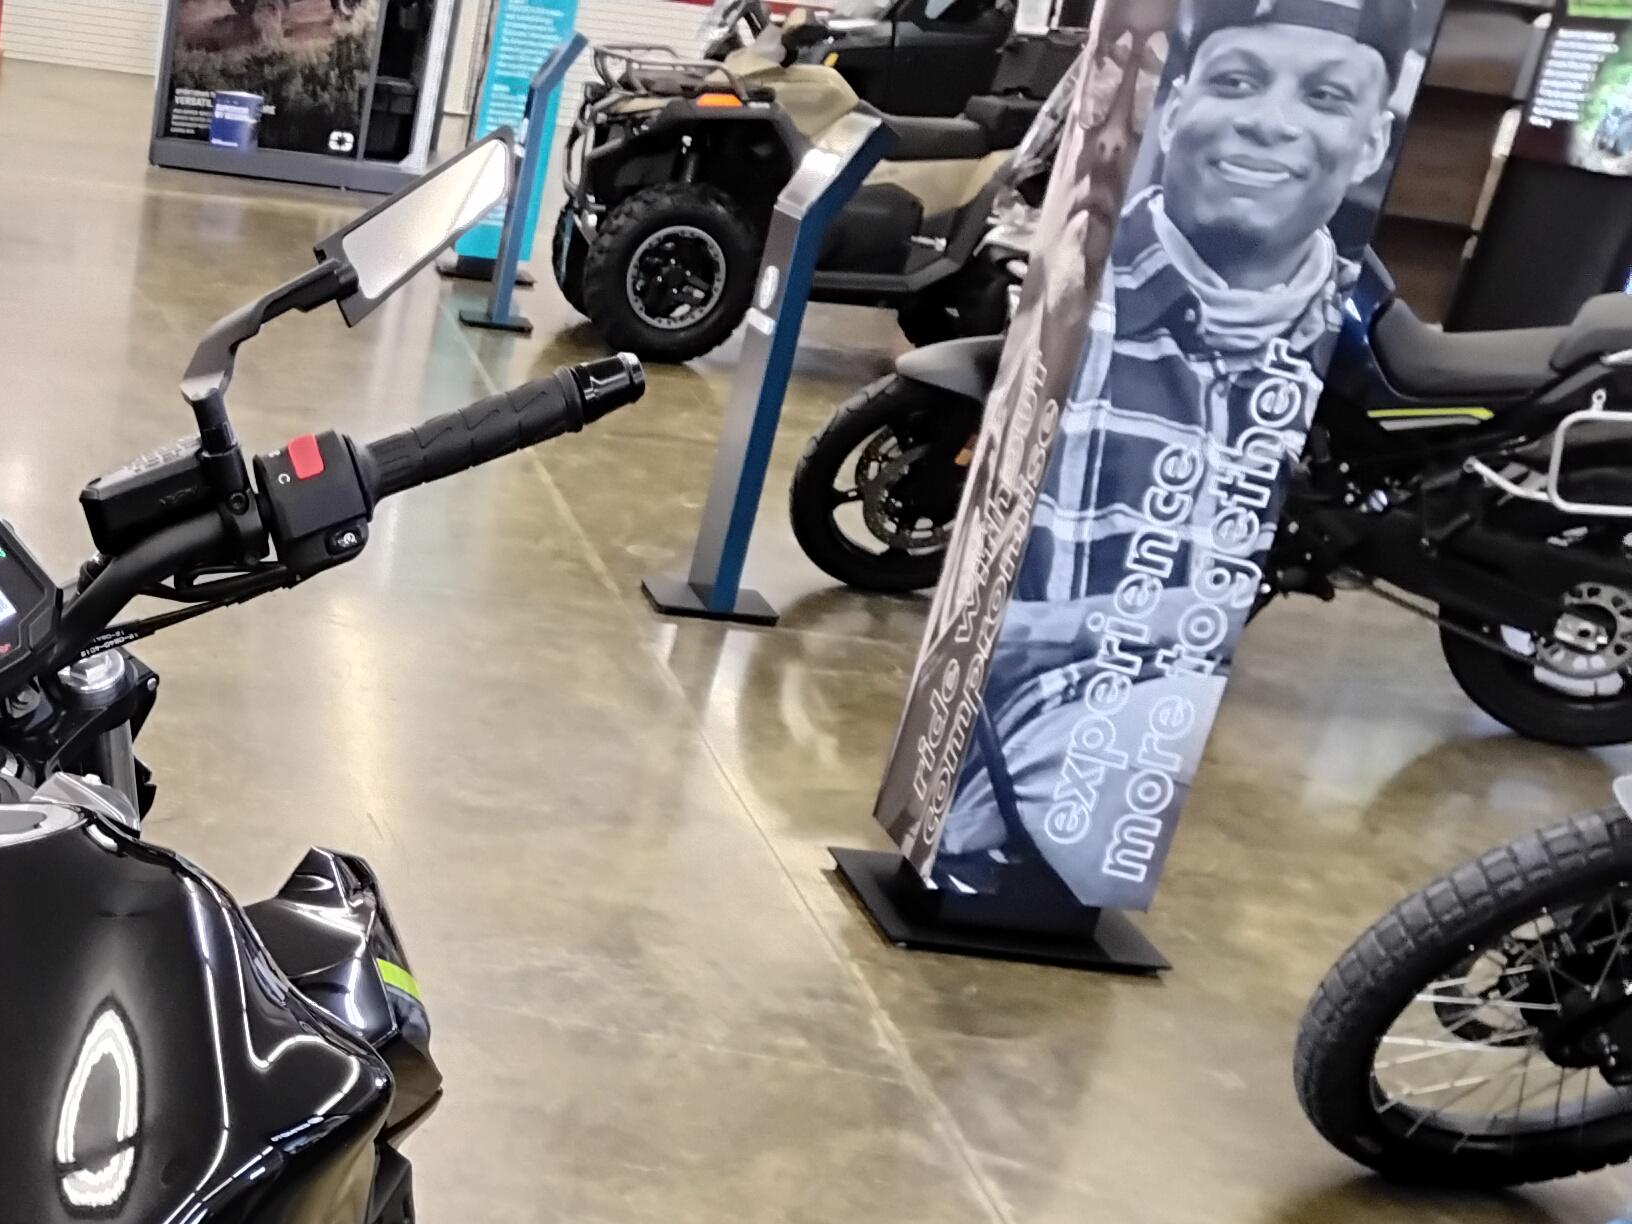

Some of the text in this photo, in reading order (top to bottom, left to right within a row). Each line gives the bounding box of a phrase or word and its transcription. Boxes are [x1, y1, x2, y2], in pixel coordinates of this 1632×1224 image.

[912, 658, 960, 801] ride
[923, 398, 1059, 845] compromise
[1043, 443, 1204, 844] experience
[1101, 337, 1313, 882] more together
